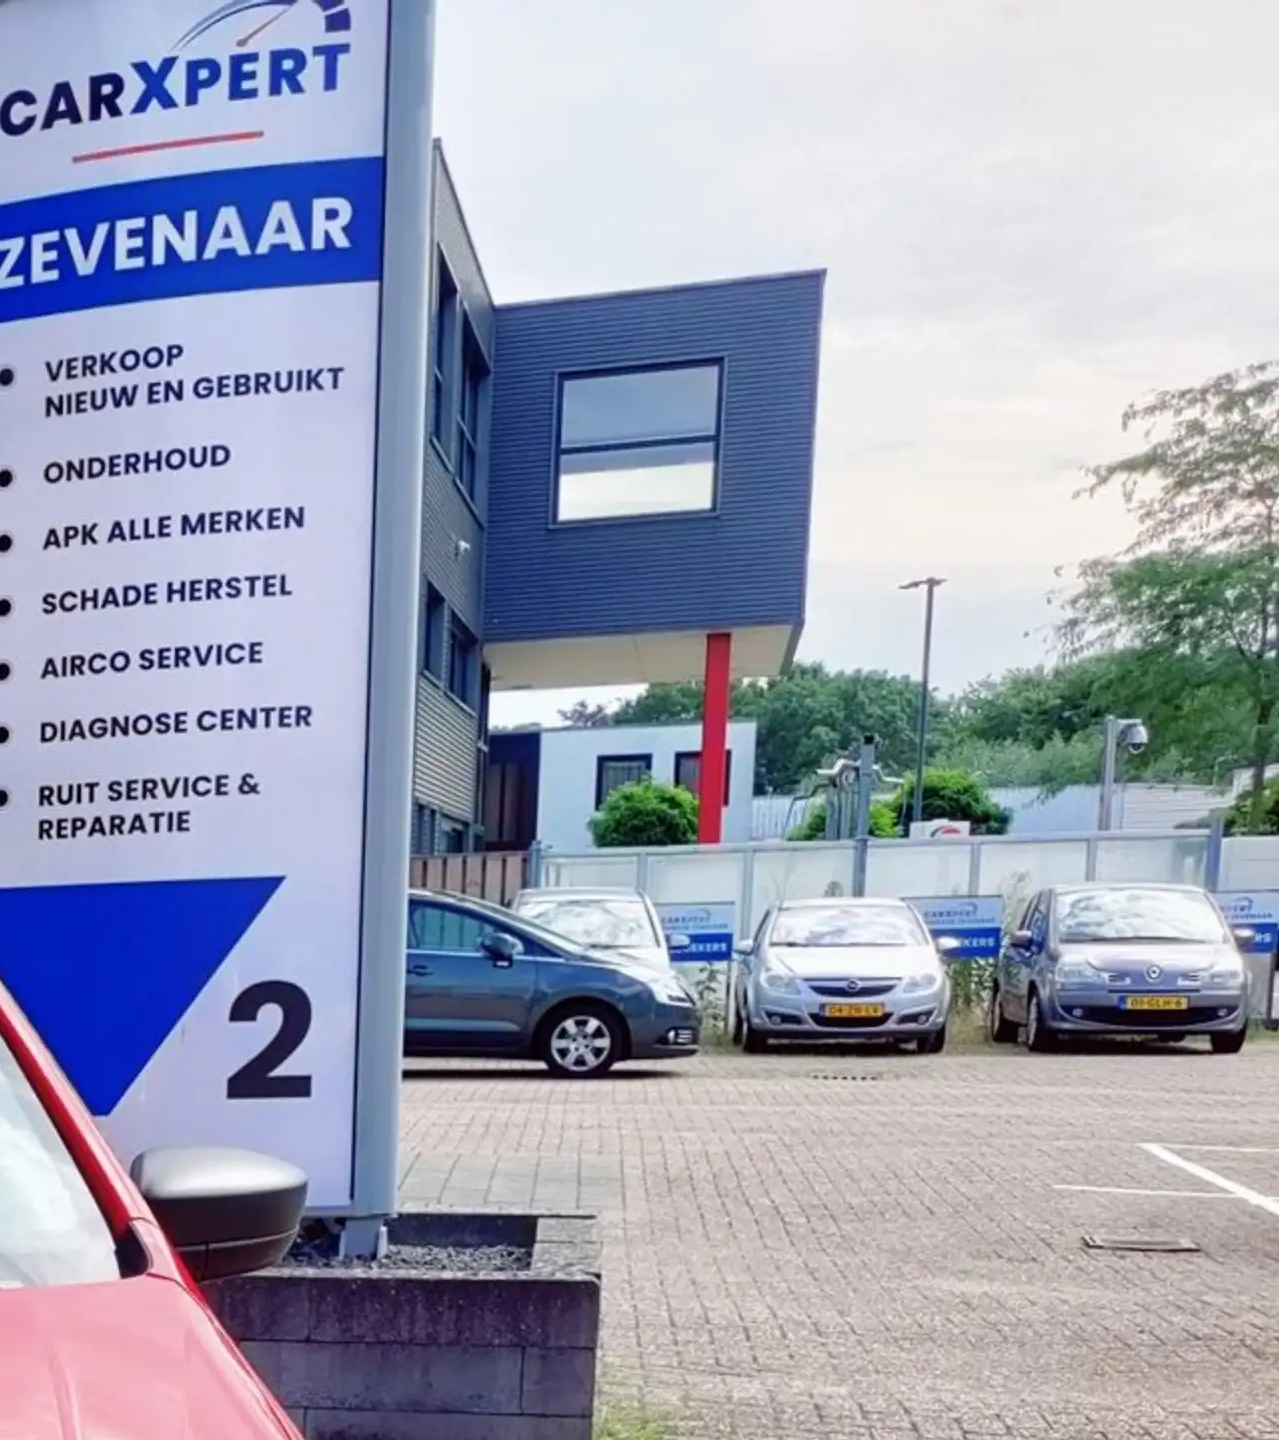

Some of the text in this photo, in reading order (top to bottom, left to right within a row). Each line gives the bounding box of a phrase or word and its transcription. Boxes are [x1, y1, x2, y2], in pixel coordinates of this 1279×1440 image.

[44, 344, 184, 382] VERKOOP
[44, 367, 346, 418] NIEUW EN GEBRUIKT
[43, 444, 231, 484] ONDERHOUD
[42, 505, 306, 551] APK ALLE MERKEN
[41, 574, 293, 615] SCHADE HERSTEL
[40, 642, 264, 680] AIRCO SERVICE
[39, 705, 314, 744] DIAGNOSE CENTER
[38, 772, 262, 808] RUIT SERVICE &
[38, 810, 191, 841] REPARATIE
[225, 978, 314, 1100] 2
